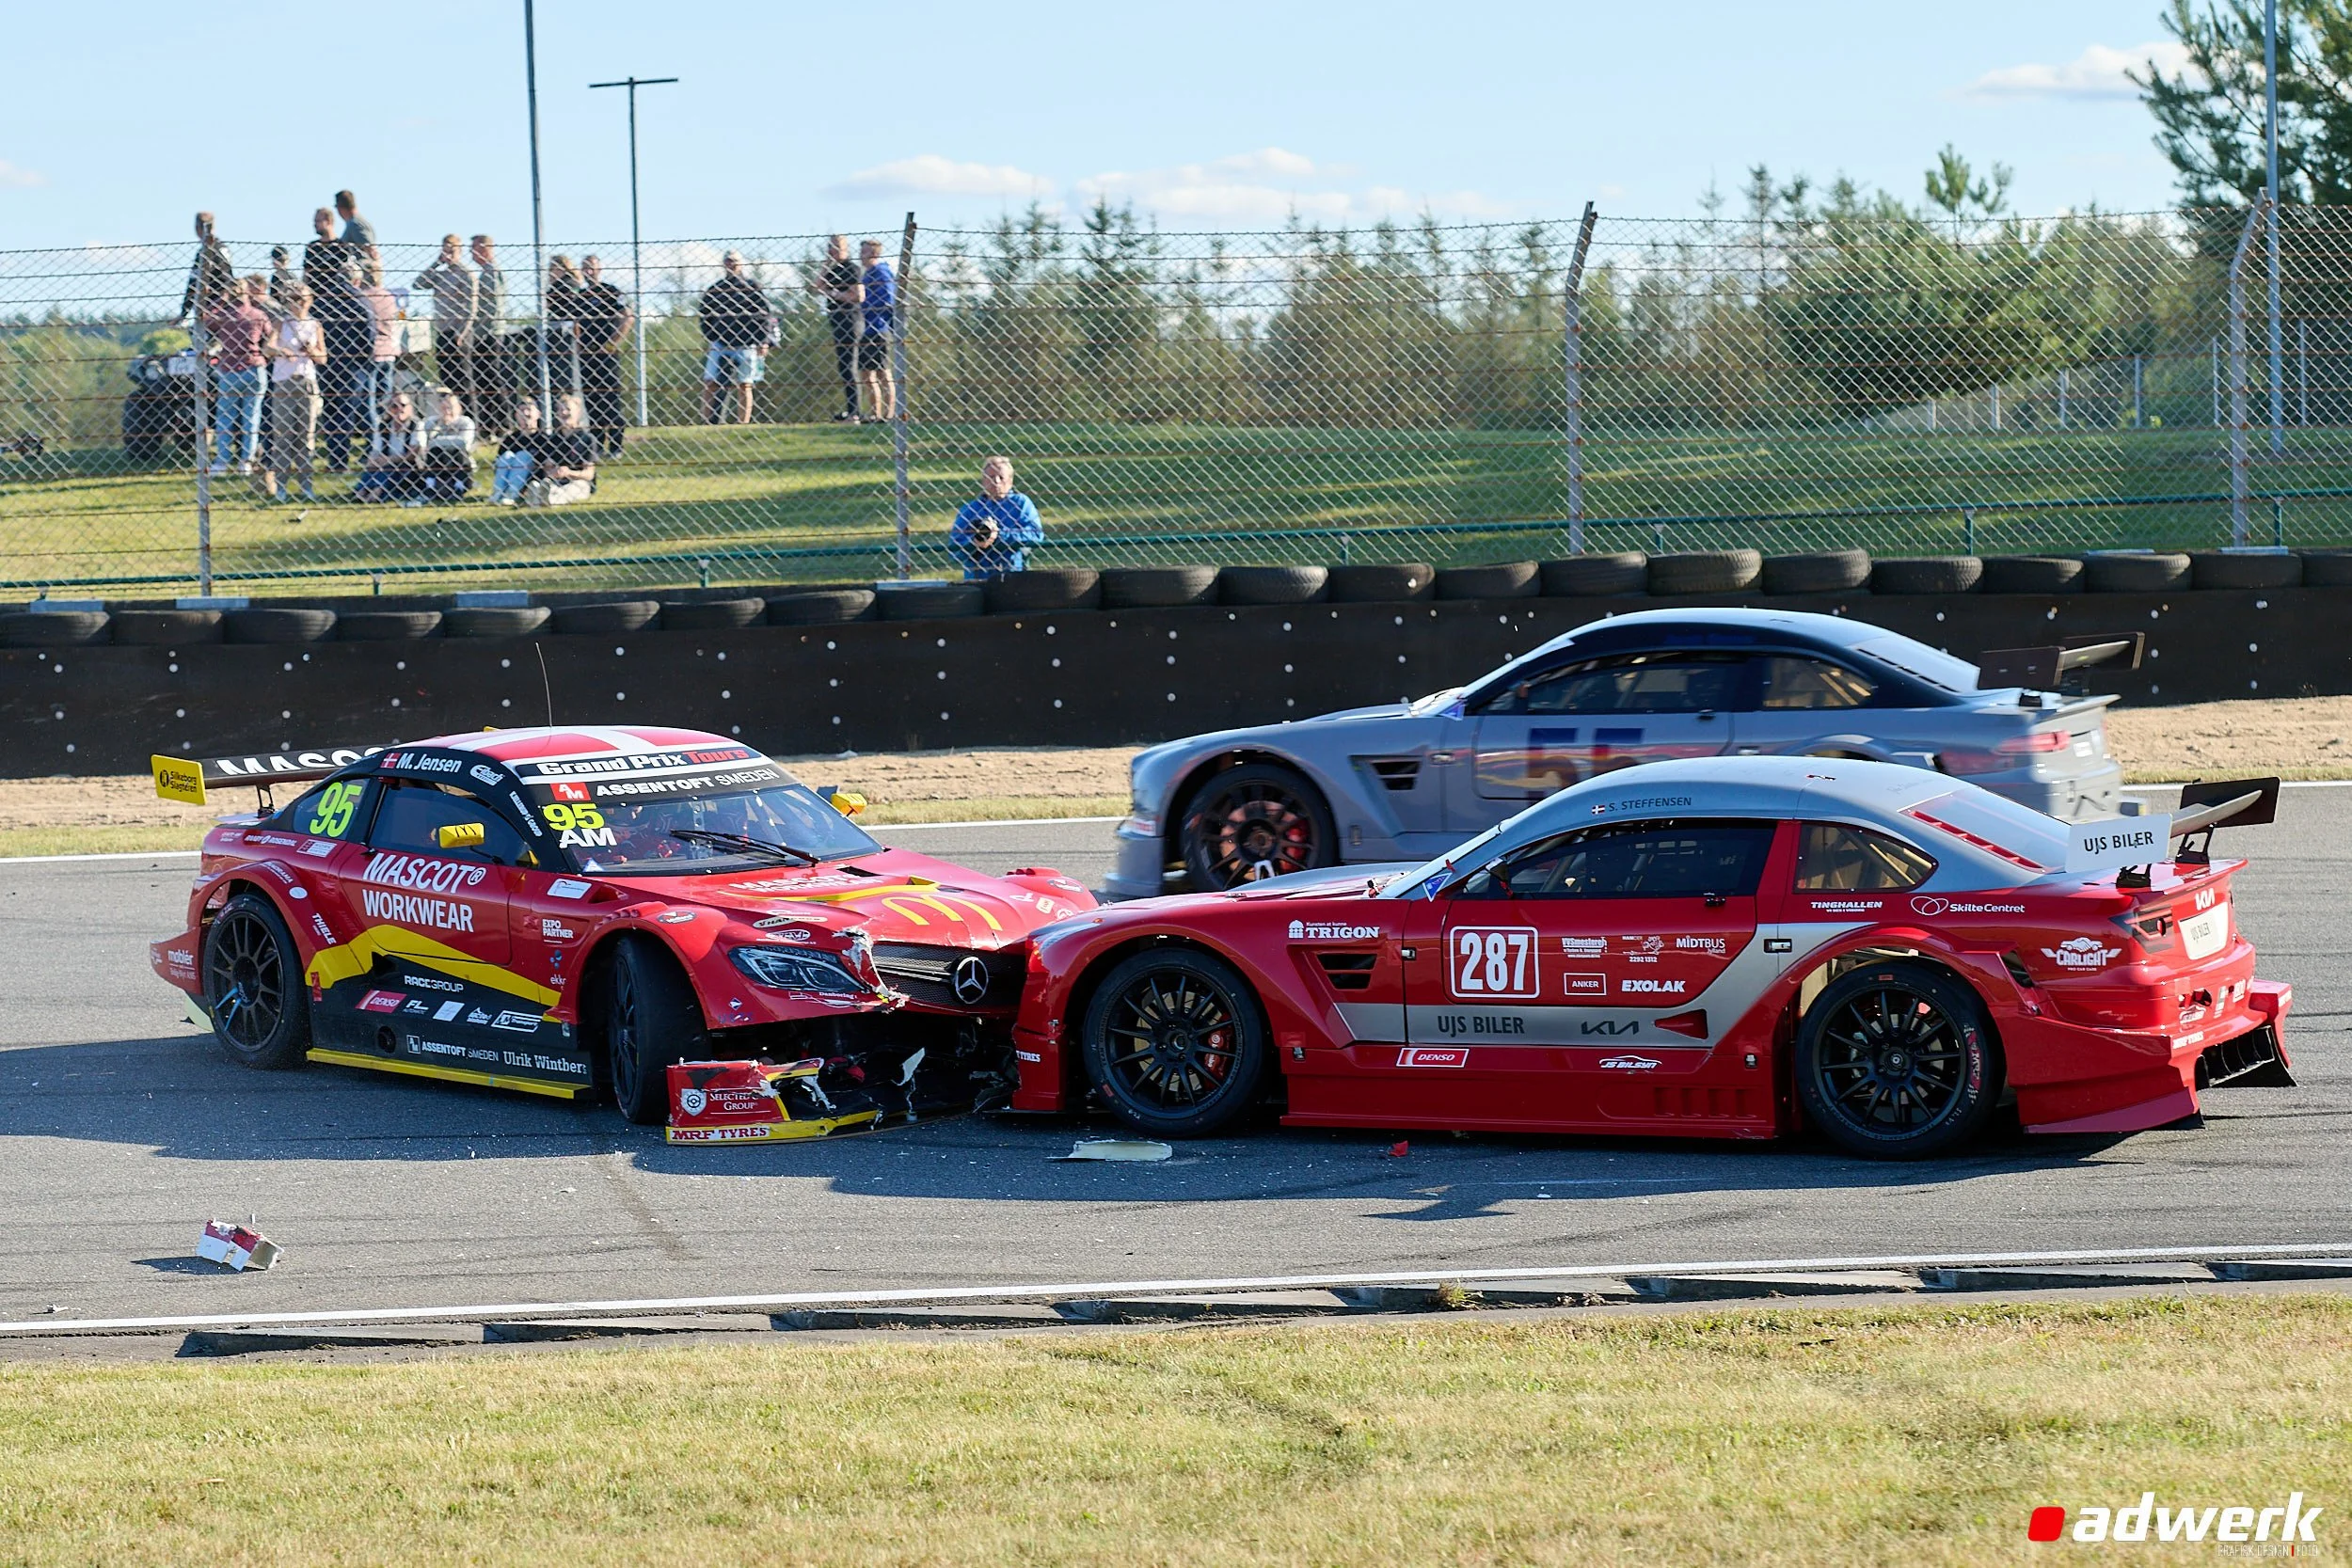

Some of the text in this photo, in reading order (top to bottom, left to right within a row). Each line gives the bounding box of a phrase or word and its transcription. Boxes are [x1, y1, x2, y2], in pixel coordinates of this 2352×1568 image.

[396, 753, 462, 773] M. Jensen
[536, 747, 750, 775] Grand Prix Tours
[596, 768, 779, 797] ASSENTOFT SMEDEN
[310, 782, 363, 838] 95
[1608, 797, 1692, 812] S. STEFFENSEN
[542, 802, 605, 832] 95
[559, 828, 618, 849] AM
[2084, 832, 2154, 854] UJS BILER
[362, 889, 474, 933] WORKWEAR
[1949, 903, 2025, 913] SkilteCentret
[311, 912, 337, 945] THIELE
[542, 918, 562, 929] EXPO
[542, 927, 574, 940] PARTNER
[1305, 927, 1380, 939] TRIGON
[1676, 935, 1725, 949] MIDTBUS
[1460, 932, 1529, 991] 287
[2056, 949, 2108, 966] CARLIGHT
[1621, 979, 1686, 992] EXOLAK
[370, 996, 401, 1008] DENSO
[1437, 1015, 1525, 1037] UJS BILER
[421, 1040, 499, 1062] ASSENTOFT SMEDEN
[1417, 1053, 1455, 1062] DENSO
[502, 1050, 583, 1074] Ulrik Winther
[723, 1101, 755, 1111] GROUP
[672, 1127, 768, 1140] MRF TYRES
